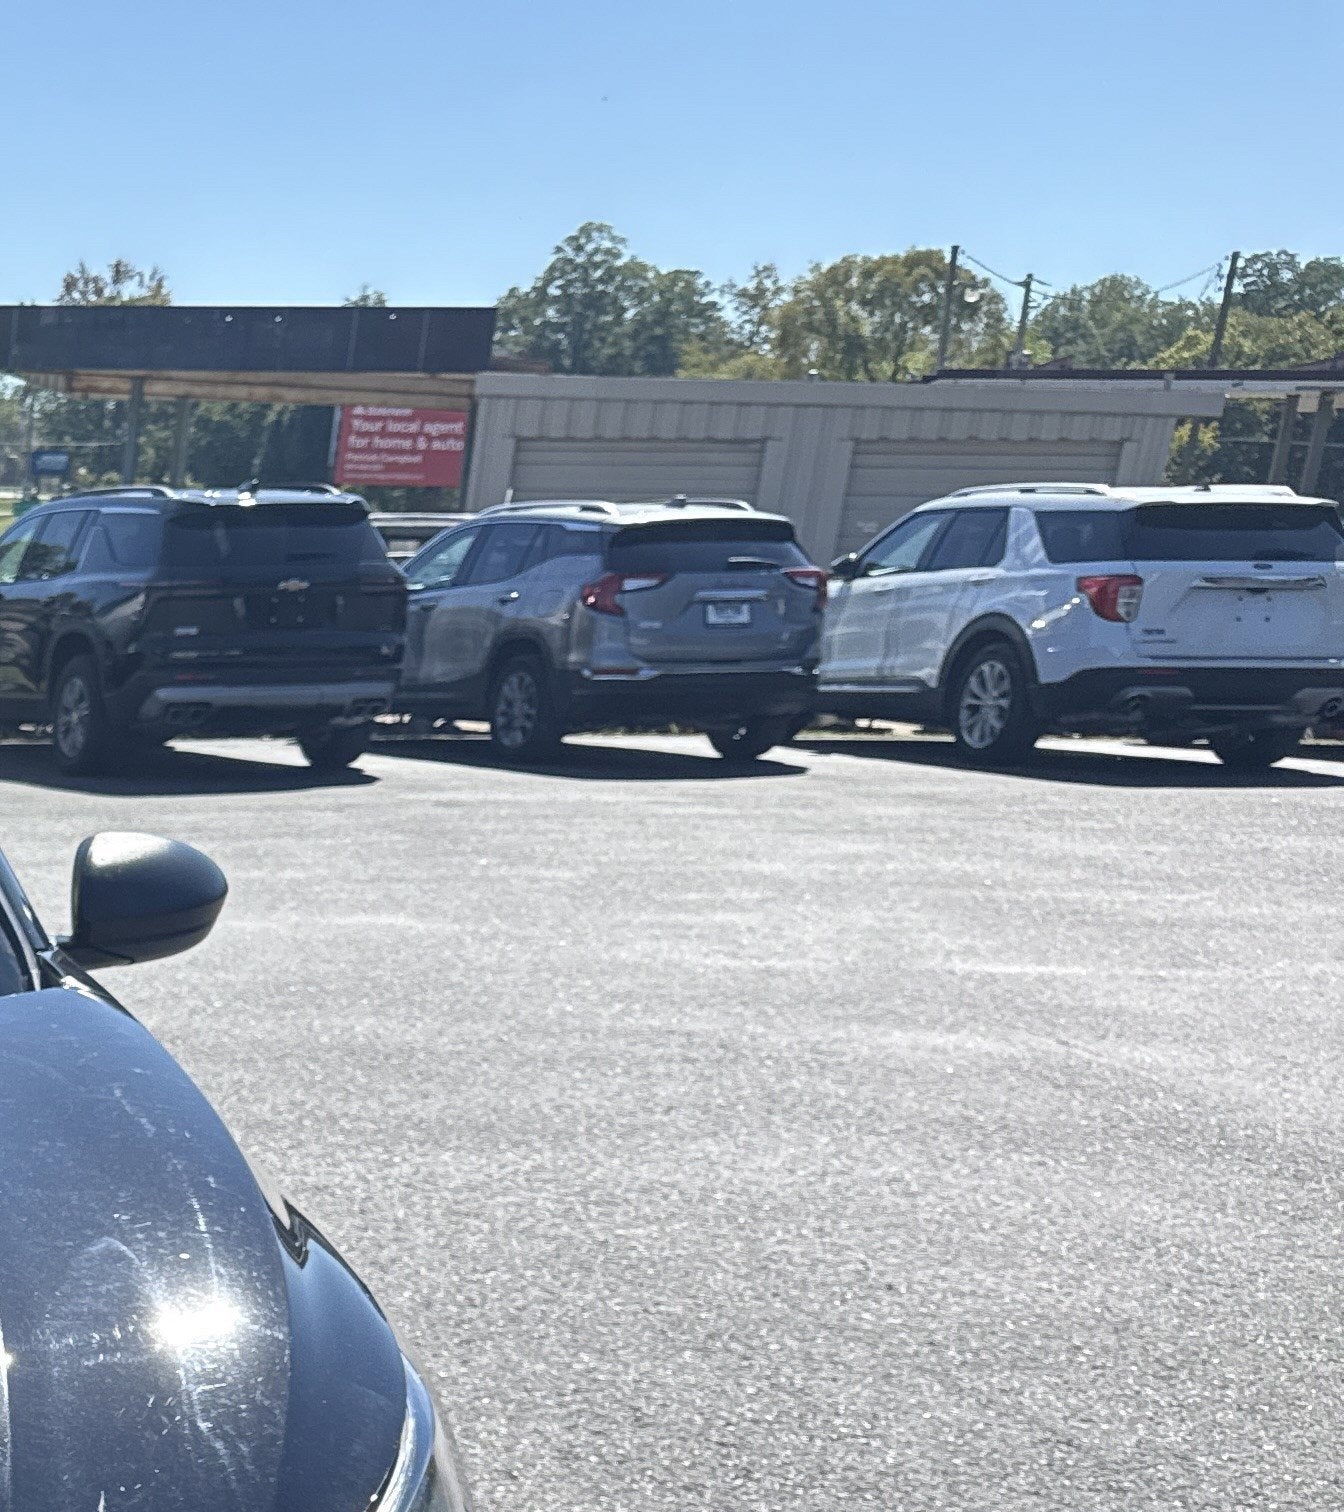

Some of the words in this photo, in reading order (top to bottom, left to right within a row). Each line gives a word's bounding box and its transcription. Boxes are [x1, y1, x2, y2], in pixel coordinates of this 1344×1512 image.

[351, 418, 384, 433] Your
[387, 418, 421, 434] local
[423, 421, 464, 437] agent
[347, 434, 370, 449] for
[372, 435, 413, 450] home
[415, 434, 428, 450] &
[431, 437, 464, 451] auto
